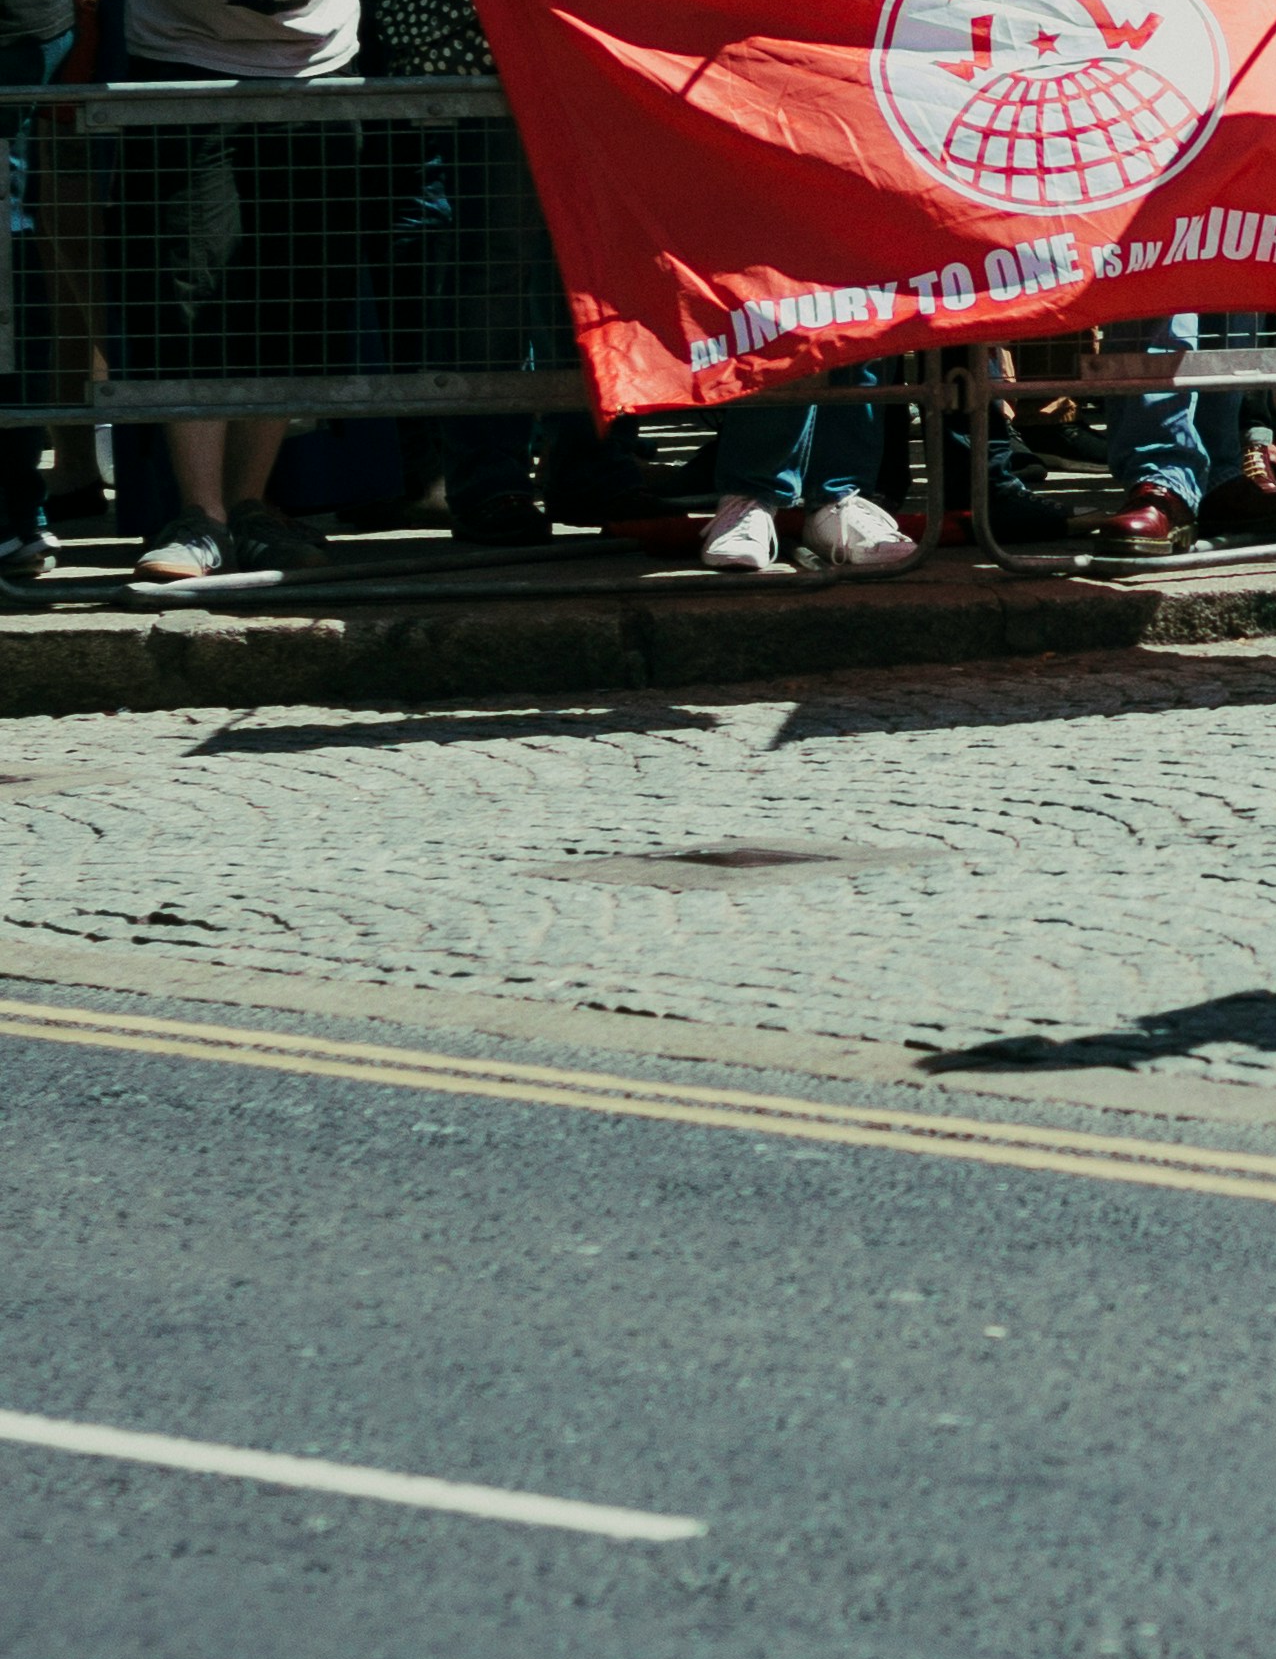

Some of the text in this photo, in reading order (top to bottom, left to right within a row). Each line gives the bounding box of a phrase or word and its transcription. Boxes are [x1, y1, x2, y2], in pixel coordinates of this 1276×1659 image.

[690, 334, 729, 373] AN
[730, 281, 899, 354] INJURY
[909, 261, 976, 315] TO
[984, 231, 1083, 301] ONE
[1090, 243, 1123, 279] IS
[1125, 241, 1162, 275] AN
